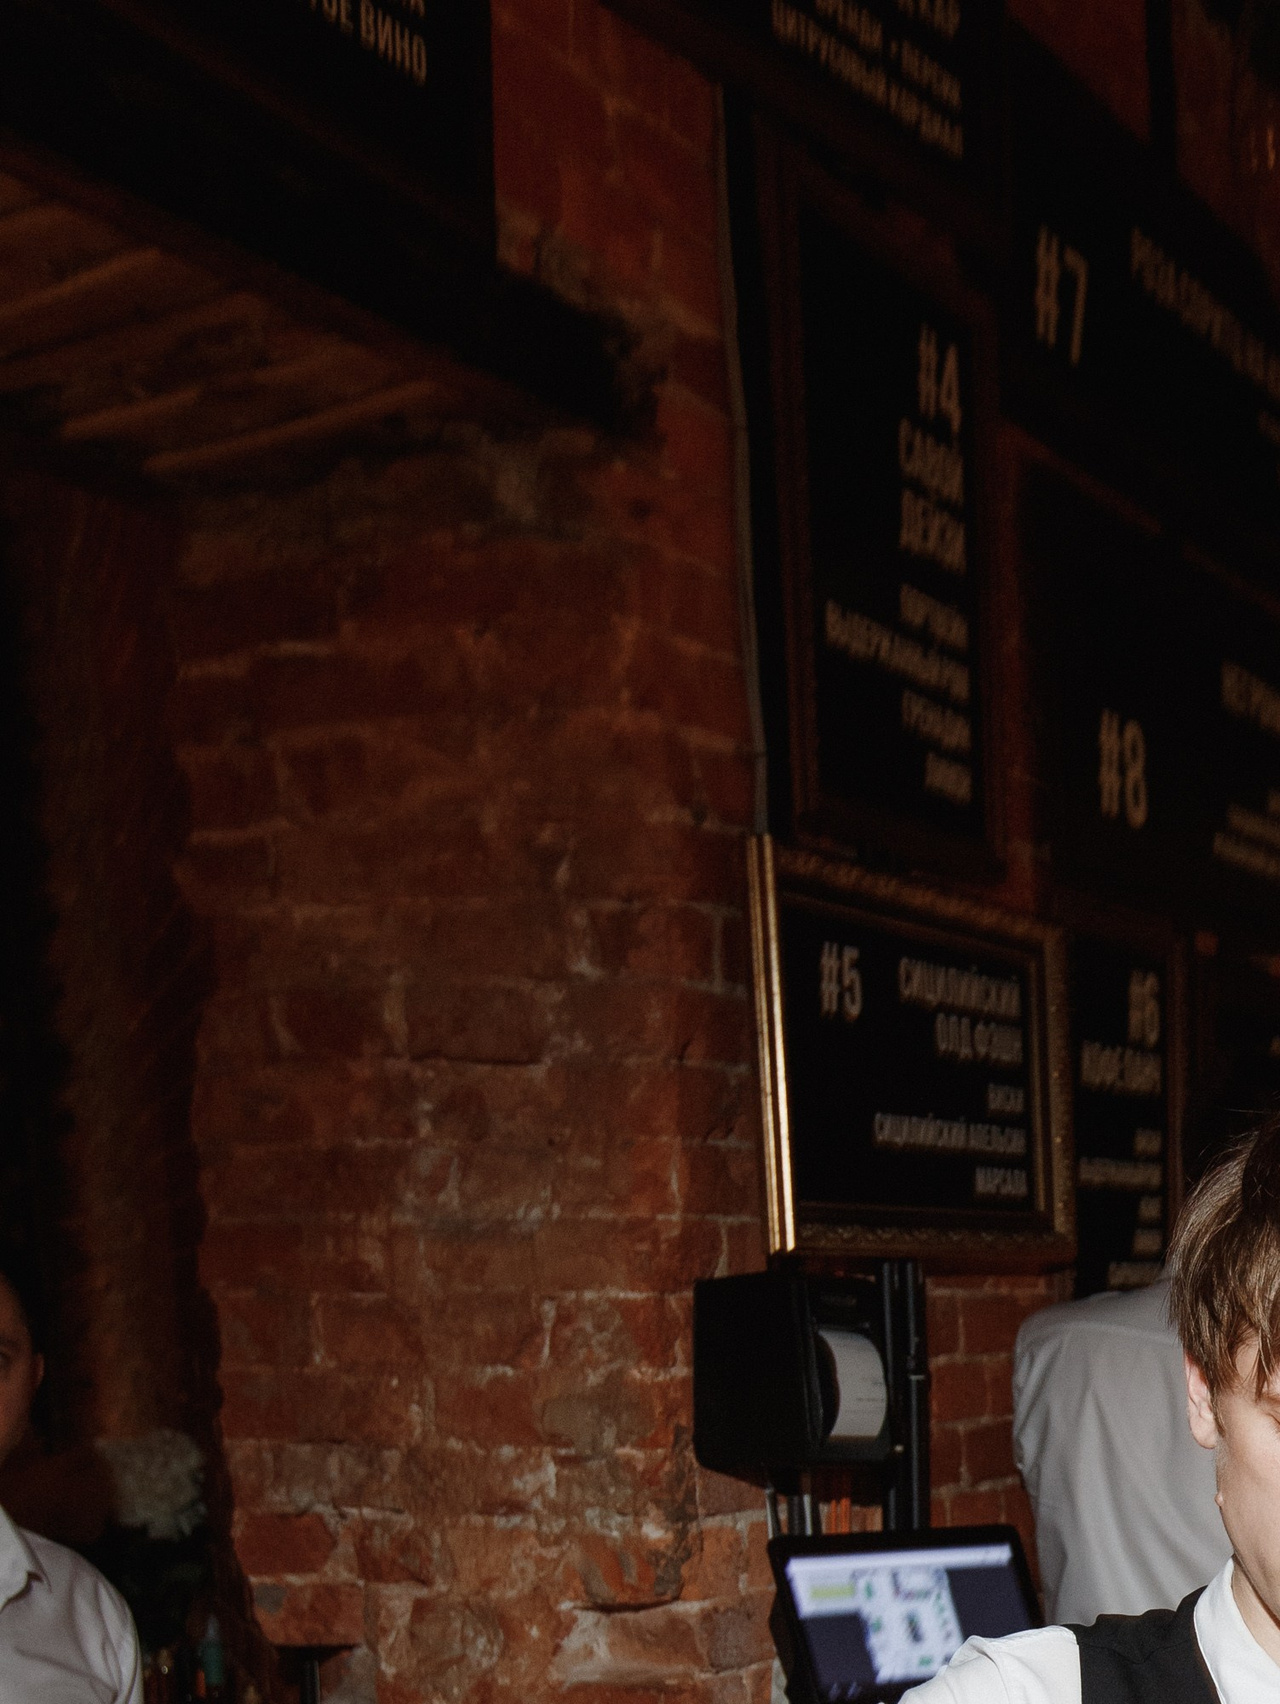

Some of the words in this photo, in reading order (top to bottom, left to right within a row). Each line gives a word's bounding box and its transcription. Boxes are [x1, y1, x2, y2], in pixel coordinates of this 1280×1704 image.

[359, 0, 428, 87] ВИНО
[1034, 224, 1088, 366] #7
[918, 323, 962, 434] #4
[1099, 709, 1149, 829] #8
[821, 941, 862, 1021] #5
